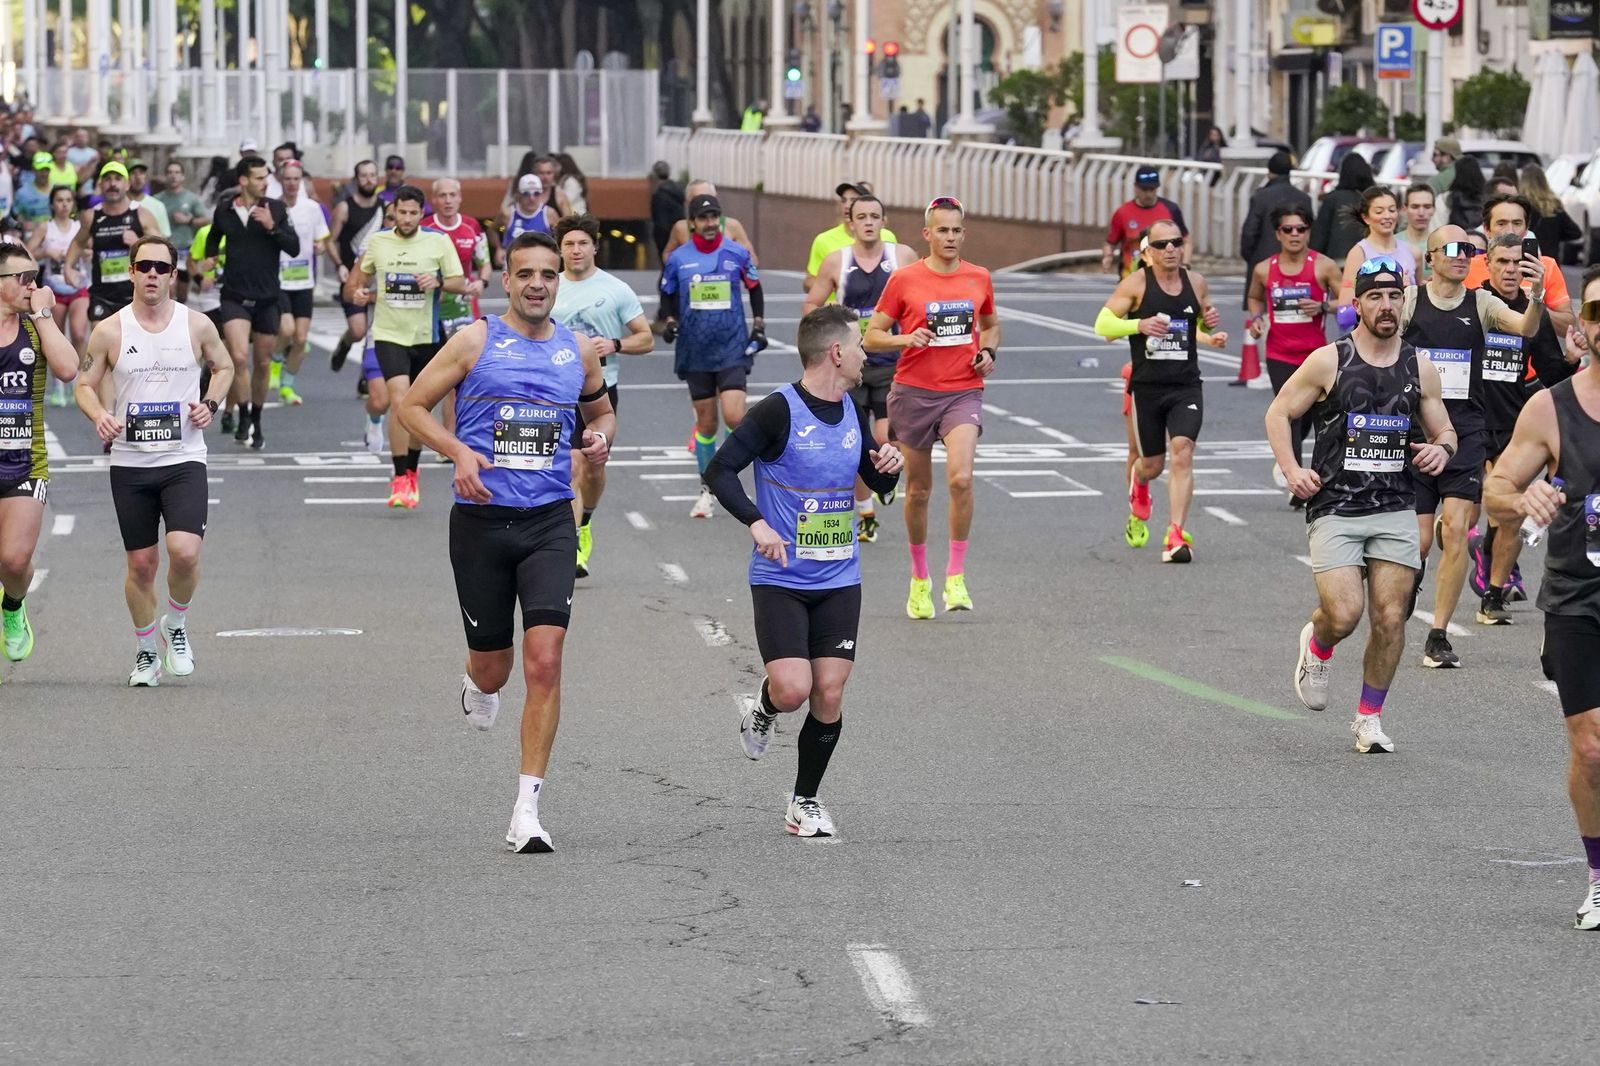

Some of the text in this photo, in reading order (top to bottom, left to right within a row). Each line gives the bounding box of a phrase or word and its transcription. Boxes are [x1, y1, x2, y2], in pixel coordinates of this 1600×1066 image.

[1381, 28, 1405, 59] P
[942, 302, 969, 310] ZURICH
[944, 315, 959, 323] 4727
[936, 324, 967, 336] CHUBY
[1159, 340, 1182, 350] NÍBAL
[1487, 336, 1517, 346] ZURICH
[1433, 352, 1465, 360] ZURICH
[1438, 366, 1446, 374] 51
[0, 402, 27, 410] ZURICH
[142, 404, 174, 413] ZURICH
[519, 408, 557, 419] ZURICH
[0, 417, 16, 425] 5093
[144, 419, 161, 427] 3857
[1369, 418, 1404, 427] ZURICH
[0, 426, 32, 438] ISTIAN
[134, 428, 172, 441] PIETRO
[519, 427, 539, 437] 3591
[1369, 434, 1388, 444] 5205
[494, 440, 540, 455] MIGUEL
[1345, 447, 1405, 460] EL CAPILLITA
[822, 500, 851, 510] ZURICH
[823, 519, 840, 528] 1534
[797, 530, 853, 546] TOÑO ROJO
